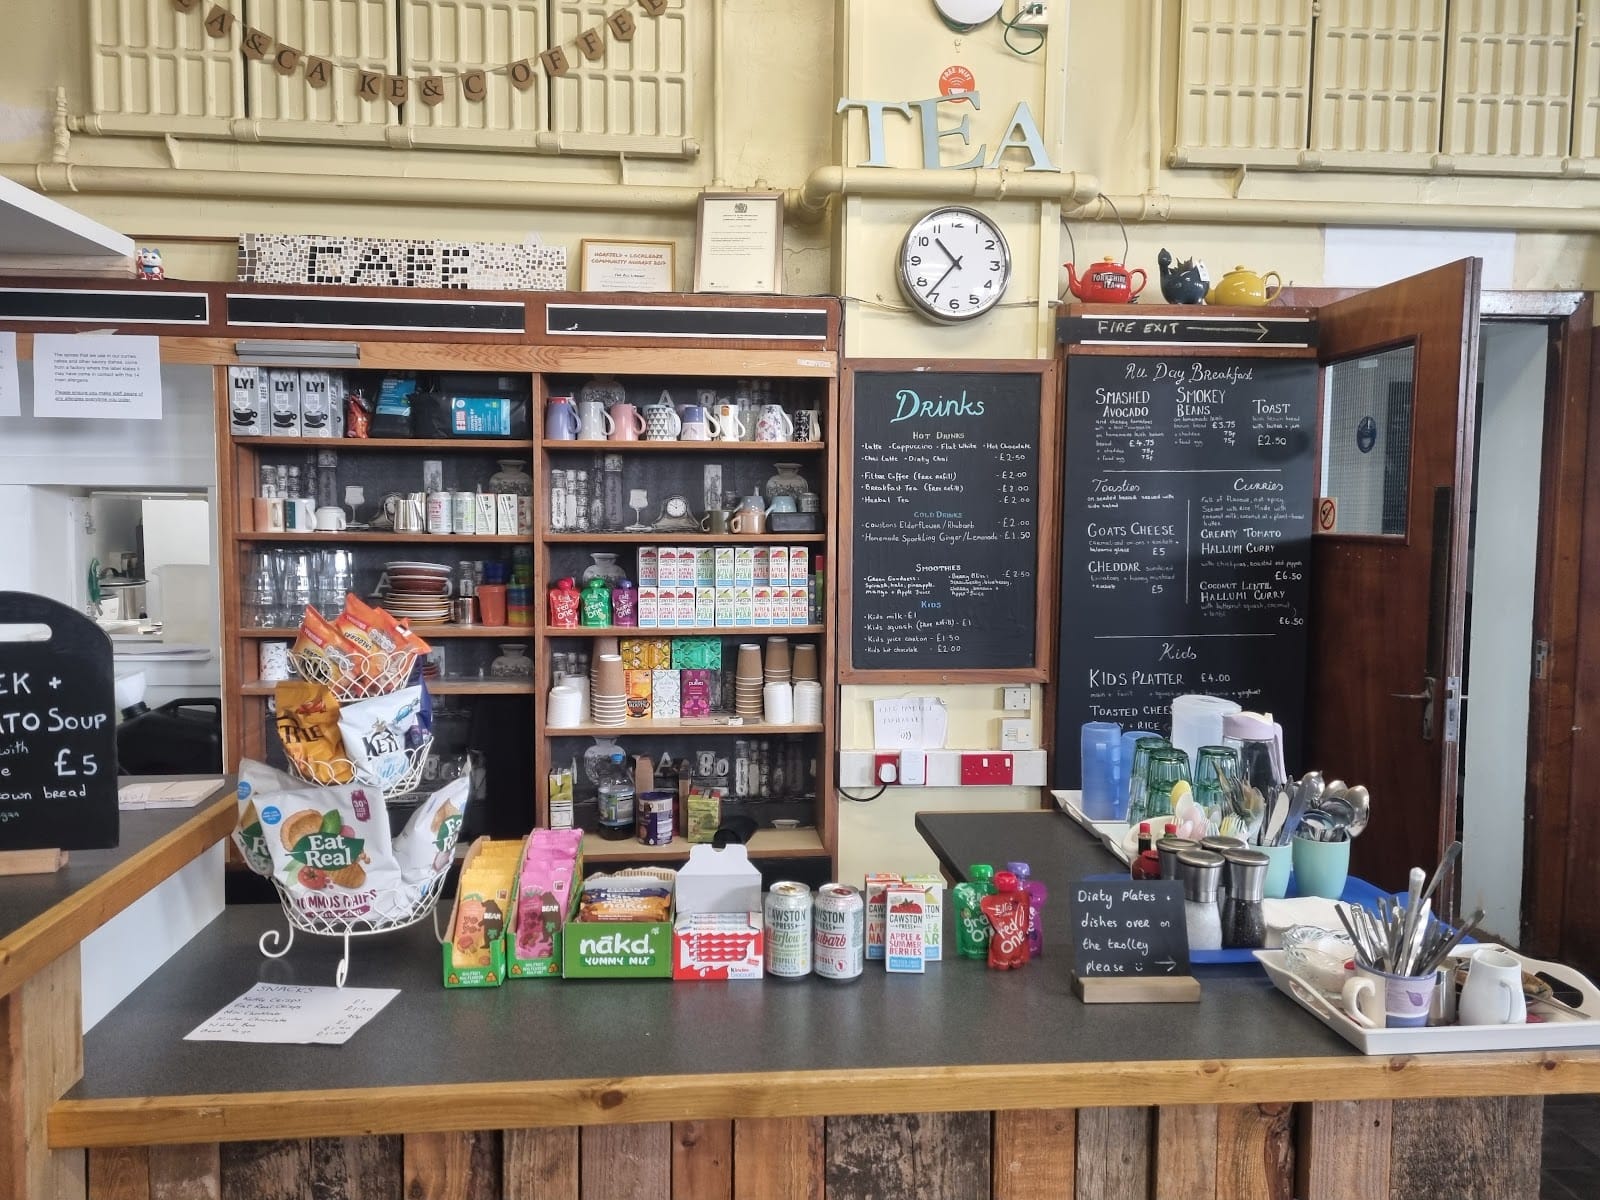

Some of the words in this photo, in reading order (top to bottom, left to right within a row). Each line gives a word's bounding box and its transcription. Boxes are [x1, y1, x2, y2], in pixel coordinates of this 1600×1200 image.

[277, 49, 406, 98] CAKE
[422, 79, 443, 97] &
[836, 90, 1061, 173] TEA
[933, 225, 941, 234] 11
[975, 224, 979, 234] 1
[918, 236, 929, 247] 10
[985, 240, 995, 250] 2
[910, 256, 922, 266] 9
[989, 260, 1001, 271] 3
[916, 276, 928, 287] 8
[983, 279, 993, 290] 4
[949, 299, 960, 309] 6
[969, 294, 980, 305] 5
[1098, 321, 1136, 334] FIRE
[1144, 322, 1180, 334] EXIT
[1153, 362, 1185, 385] Day
[1188, 362, 1253, 384] Breakfast
[235, 378, 254, 389] LY!
[275, 381, 294, 391] LY!
[306, 382, 325, 392] LY!
[1095, 387, 1151, 405] SMASHED
[1176, 386, 1226, 403] SMOKEY
[890, 389, 985, 423] Drinks
[1102, 405, 1149, 418] AVOCADO
[1177, 404, 1211, 417] BEANS
[1252, 399, 1291, 414] TOAST
[1233, 478, 1284, 491] Curries
[1088, 523, 1126, 537] GOATS
[1131, 522, 1175, 535] CHEESE
[1201, 529, 1237, 538] CREAMY
[1243, 528, 1281, 538] TOMATO
[1153, 547, 1165, 556] £5
[1246, 543, 1275, 553] CURRY
[916, 564, 961, 572] SMOOTHIES
[1088, 561, 1141, 572] CHEDDAR
[1275, 571, 1302, 580] £6.50
[1152, 585, 1163, 593] £5
[1200, 581, 1237, 590] COCONUT
[1201, 592, 1246, 602] HALLUMI
[1254, 590, 1285, 600] CURRY
[1280, 617, 1303, 625] £6.50
[888, 623, 912, 632] squash
[1158, 642, 1198, 662] Kids
[1089, 669, 1127, 688] KIDS
[1132, 670, 1184, 686] PLATTER
[1201, 672, 1231, 683] £4.00
[1089, 705, 1138, 717] TOASTED
[48, 708, 107, 732] SOUP
[1138, 722, 1160, 730] RICE
[54, 748, 97, 776] £5
[43, 784, 86, 798] bread
[308, 835, 346, 850] Eat
[304, 848, 352, 868] Real
[1078, 890, 1112, 909] Dirty
[890, 915, 922, 923] CAWSTON
[1081, 912, 1118, 928] dishes
[1126, 919, 1150, 928] over
[1160, 920, 1170, 928] on
[1082, 938, 1102, 950] the
[1108, 938, 1149, 956] trolley
[585, 957, 624, 965] YUMMY
[629, 957, 650, 965] MIX
[1086, 960, 1124, 974] please
